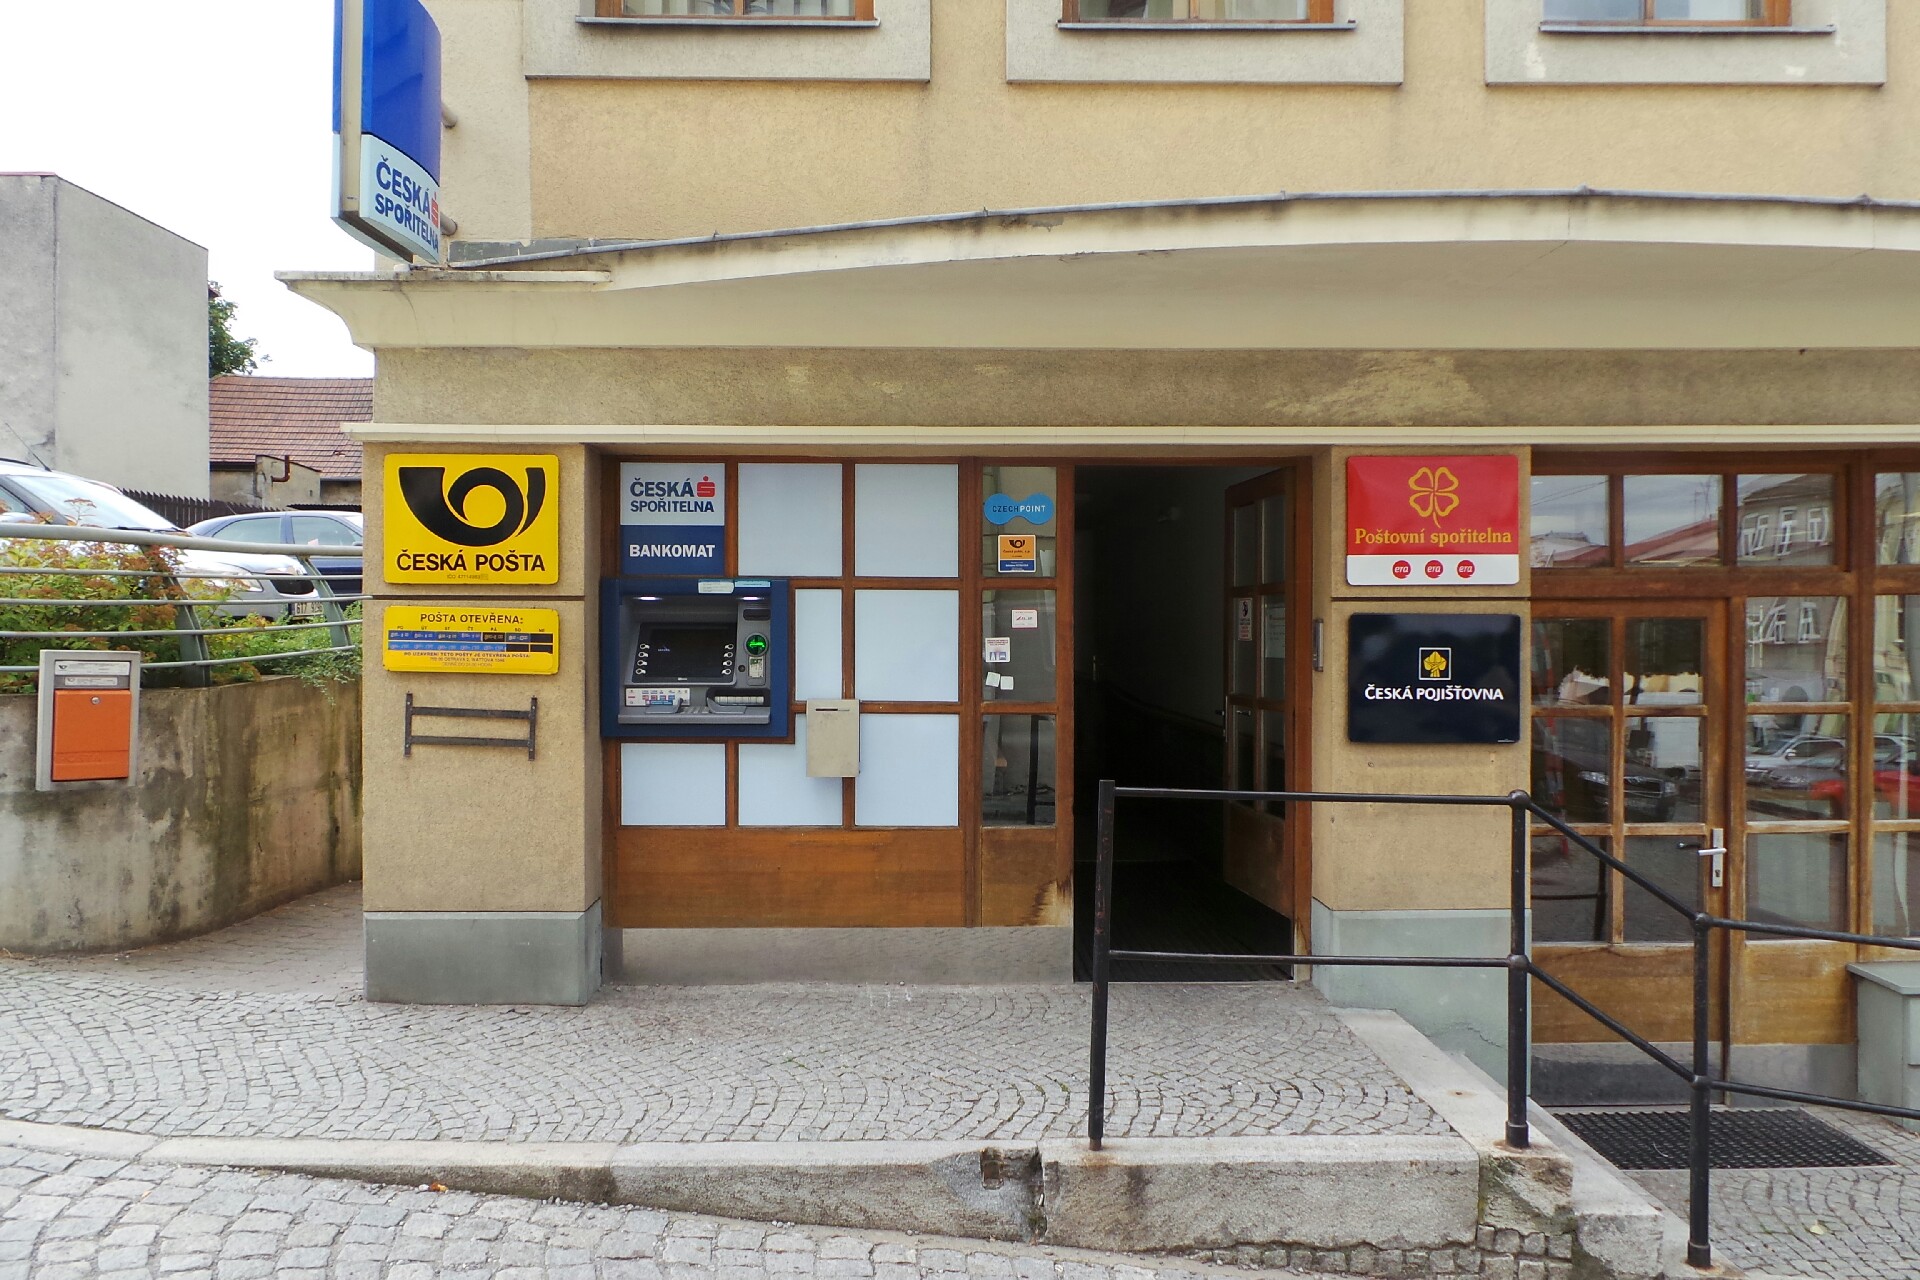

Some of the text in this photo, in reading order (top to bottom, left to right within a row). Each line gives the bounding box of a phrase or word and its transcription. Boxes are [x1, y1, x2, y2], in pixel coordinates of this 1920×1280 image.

[376, 155, 430, 219] ČESKÁ
[375, 193, 439, 253] SPOŘITELNA
[630, 477, 694, 498] ČESKÁ
[630, 498, 715, 513] SPOŘITELNA
[1355, 527, 1512, 547] Poštovní spořitelna
[396, 549, 546, 572] ČESKÁ POŠTA
[629, 544, 715, 558] BANKOMAT
[1427, 565, 1441, 573] era
[1459, 565, 1473, 573] era
[420, 612, 524, 624] POŠTA OTEVŘENA:
[1365, 684, 1504, 702] ČESKÁ POJIŠŤOVNA
